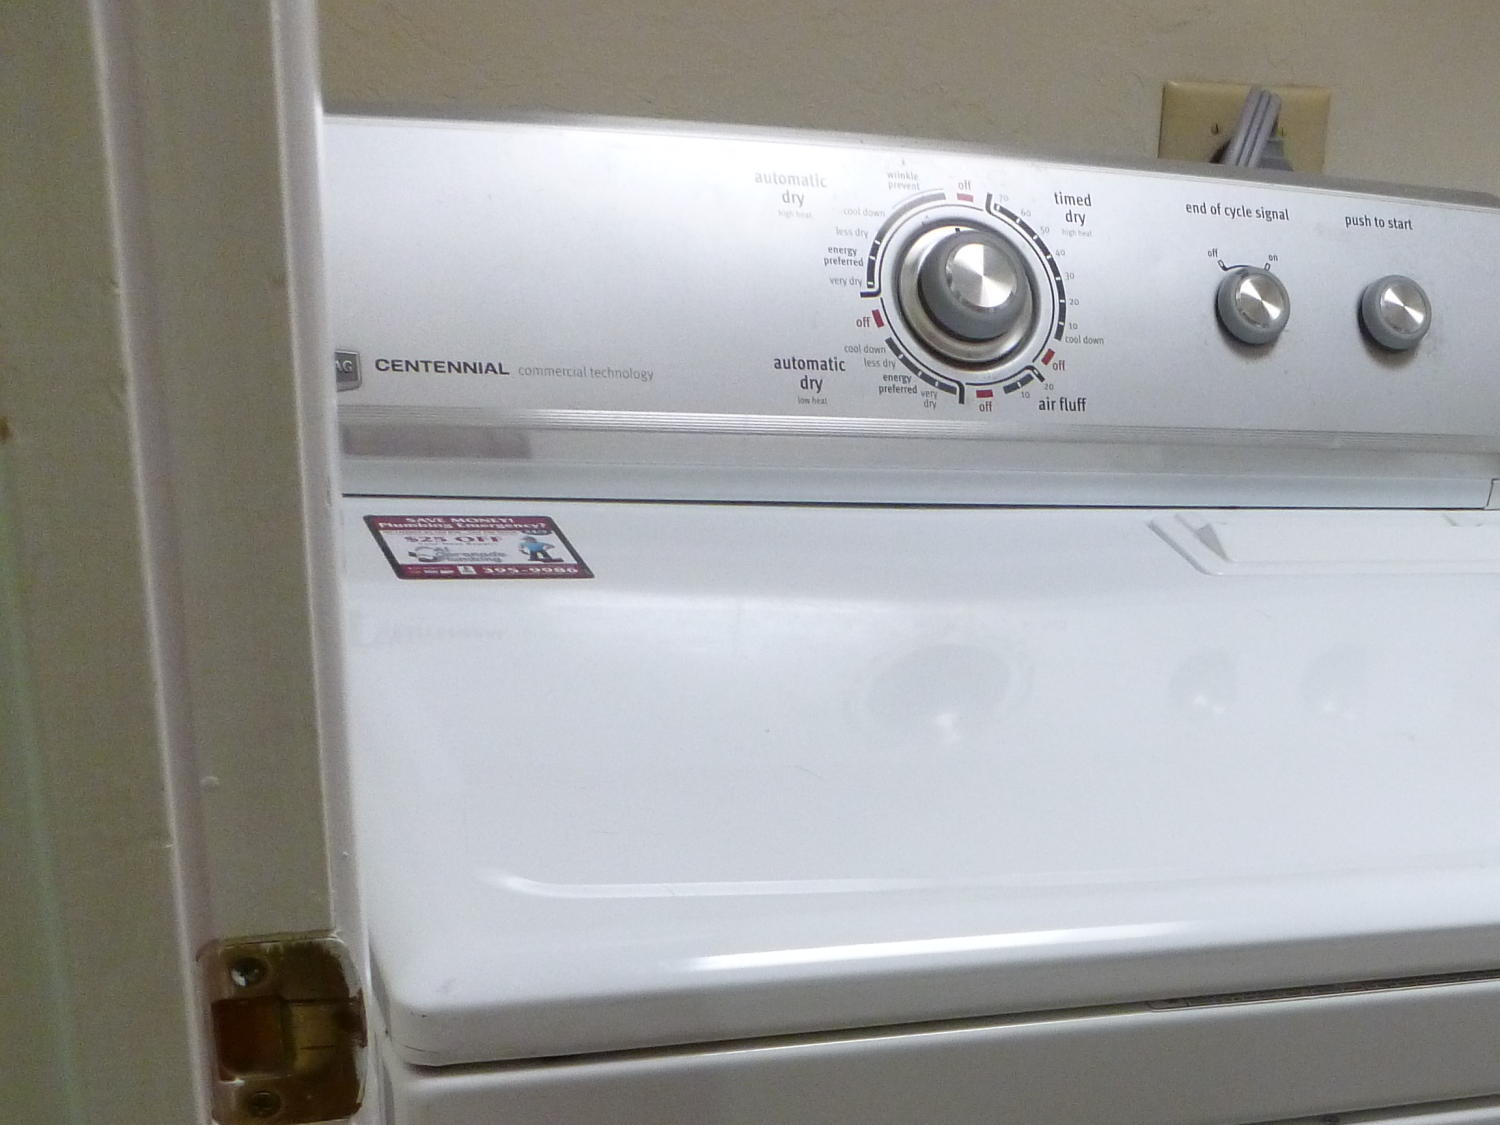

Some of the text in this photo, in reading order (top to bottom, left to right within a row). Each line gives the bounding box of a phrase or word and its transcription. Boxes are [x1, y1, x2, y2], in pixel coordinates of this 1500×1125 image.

[754, 171, 828, 189] automatic
[887, 171, 919, 181] wrinkle
[888, 180, 920, 192] prevent
[958, 180, 972, 190] off
[782, 190, 805, 208] dry
[1054, 192, 1092, 207] timed
[843, 207, 886, 217] cool down
[1065, 209, 1086, 226] dry
[1185, 202, 1290, 222] end of cycle signal
[1344, 214, 1413, 231] push to start
[836, 226, 869, 239] less dry
[1040, 226, 1050, 234] 50
[828, 246, 858, 257] energy
[1055, 249, 1066, 257] 40
[1208, 247, 1218, 258] off
[1268, 253, 1278, 262] on
[824, 256, 864, 268] preferred
[830, 276, 863, 288] very dry
[1065, 272, 1075, 280] 30
[1069, 298, 1080, 306] 20
[856, 316, 872, 328] off
[1068, 322, 1078, 330] 10
[1065, 336, 1105, 345] cool down
[844, 344, 886, 354] cool down
[375, 358, 654, 382] CENTENNIAL commercial technology
[774, 356, 846, 372] automatic
[864, 358, 896, 370] less dry
[1052, 360, 1066, 372] off
[800, 374, 823, 394] dry
[882, 374, 912, 384] energy
[878, 384, 918, 396] preferred
[1044, 383, 1054, 392] 20
[921, 390, 938, 400] very
[1021, 391, 1030, 399] 10
[923, 398, 937, 410] dry
[979, 400, 992, 412] off
[1038, 396, 1088, 412] air fluff
